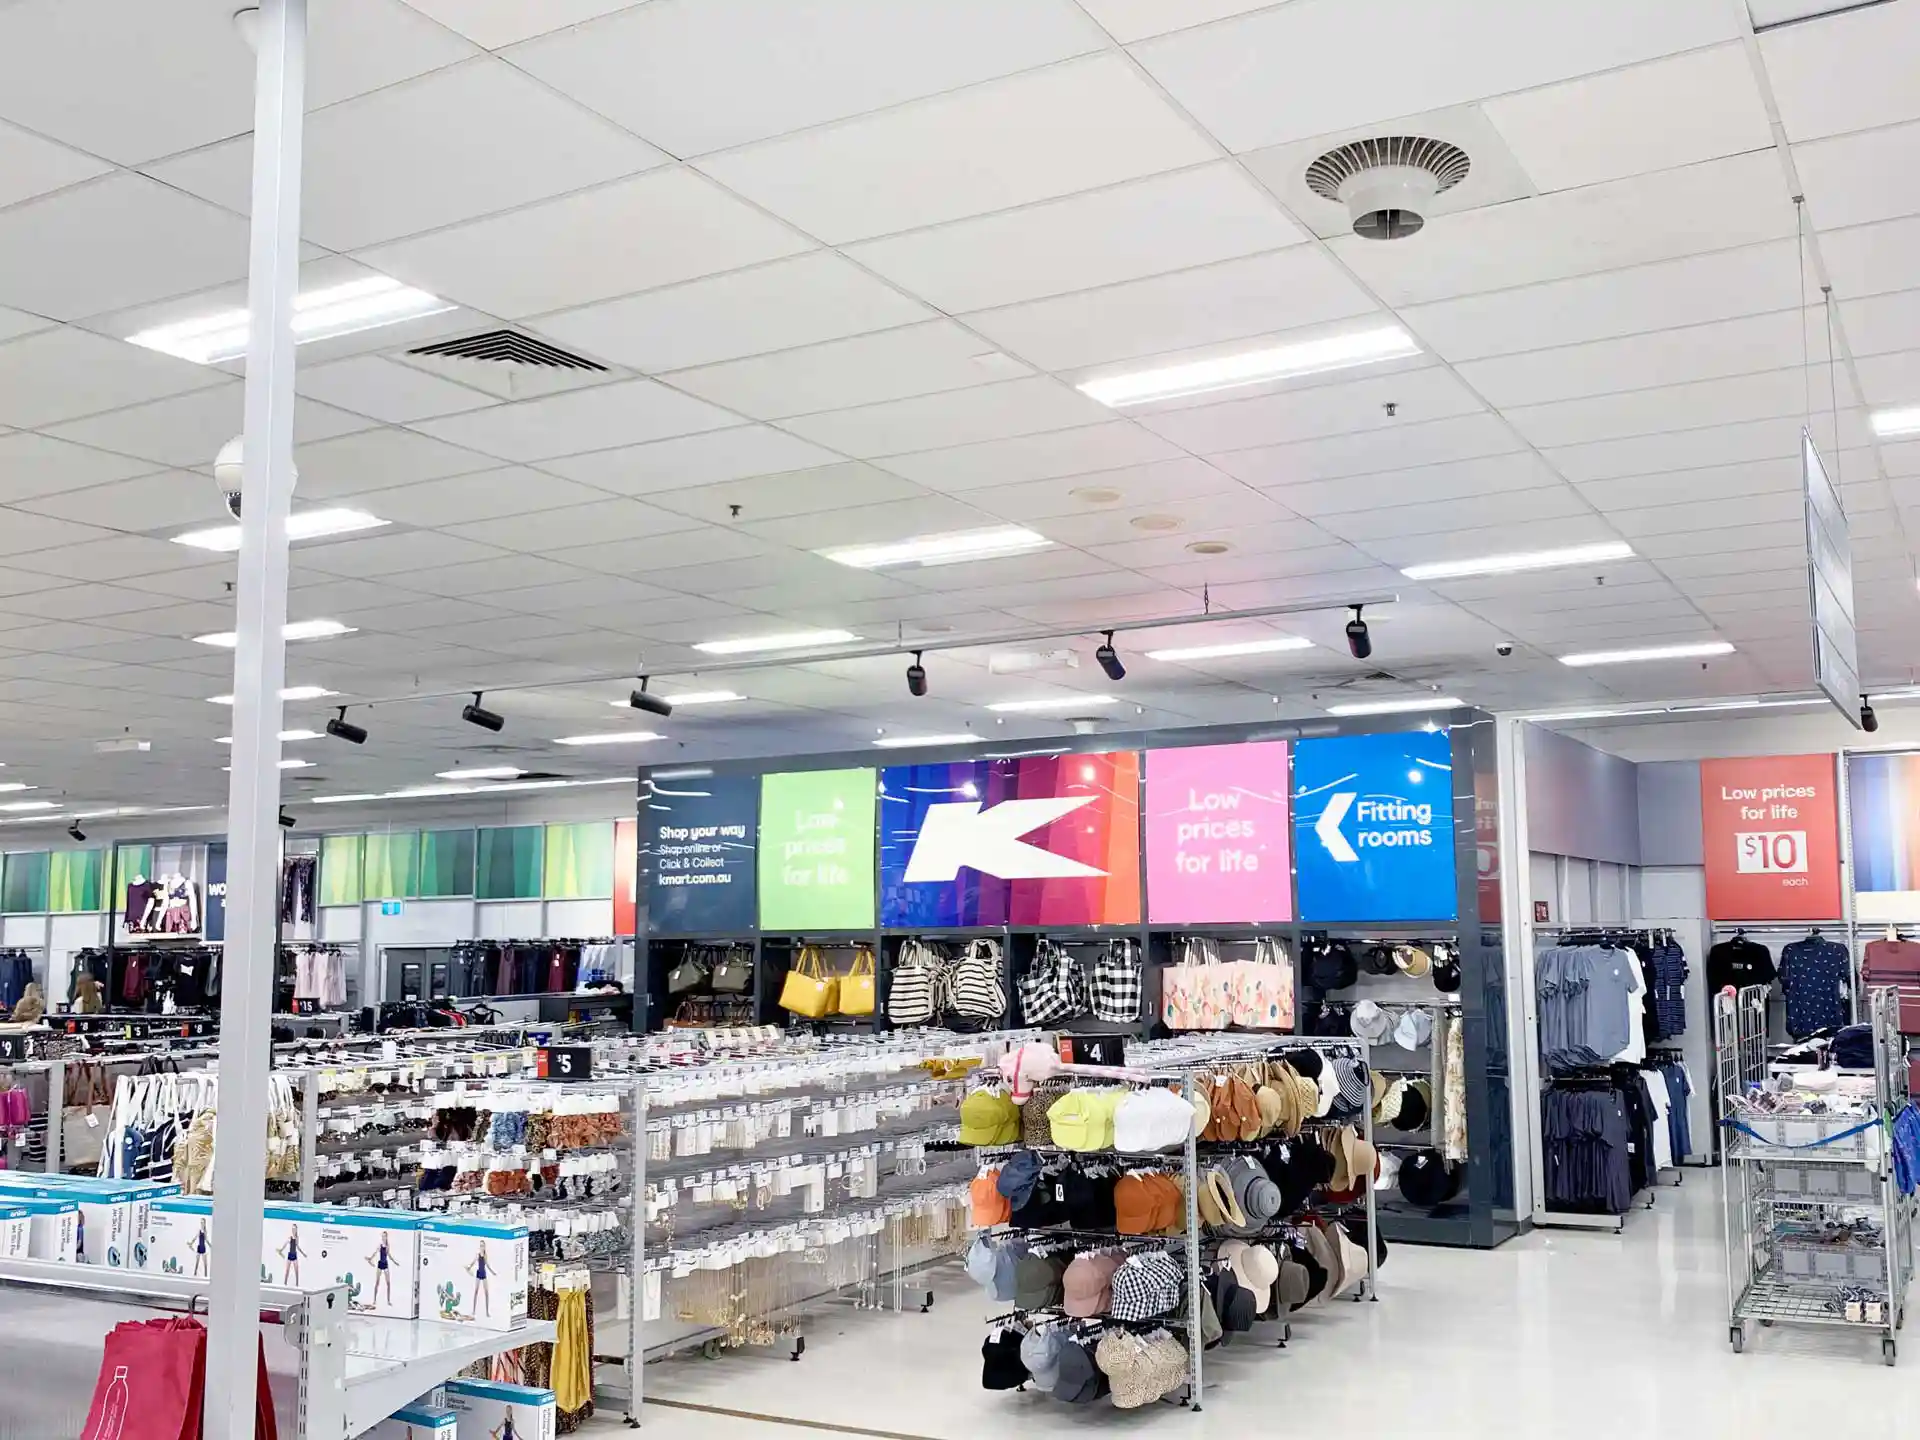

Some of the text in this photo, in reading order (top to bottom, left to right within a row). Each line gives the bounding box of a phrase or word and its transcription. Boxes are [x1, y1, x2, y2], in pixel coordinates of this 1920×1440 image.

[1188, 787, 1241, 811] Low
[1722, 784, 1816, 802] Low prices
[1357, 799, 1431, 825] Fitting
[1741, 804, 1798, 819] for life
[660, 825, 745, 841] Shop your way
[1178, 816, 1255, 845] prices
[1358, 830, 1432, 847] rooms
[660, 844, 682, 856] Shop
[1745, 834, 1797, 869] $10
[660, 857, 725, 869] Click & Collect
[1175, 848, 1259, 873] for life
[659, 873, 731, 885] kmart.com.au
[1782, 877, 1809, 887] each
[1084, 1043, 1102, 1062] $4
[556, 1054, 572, 1074] $5
